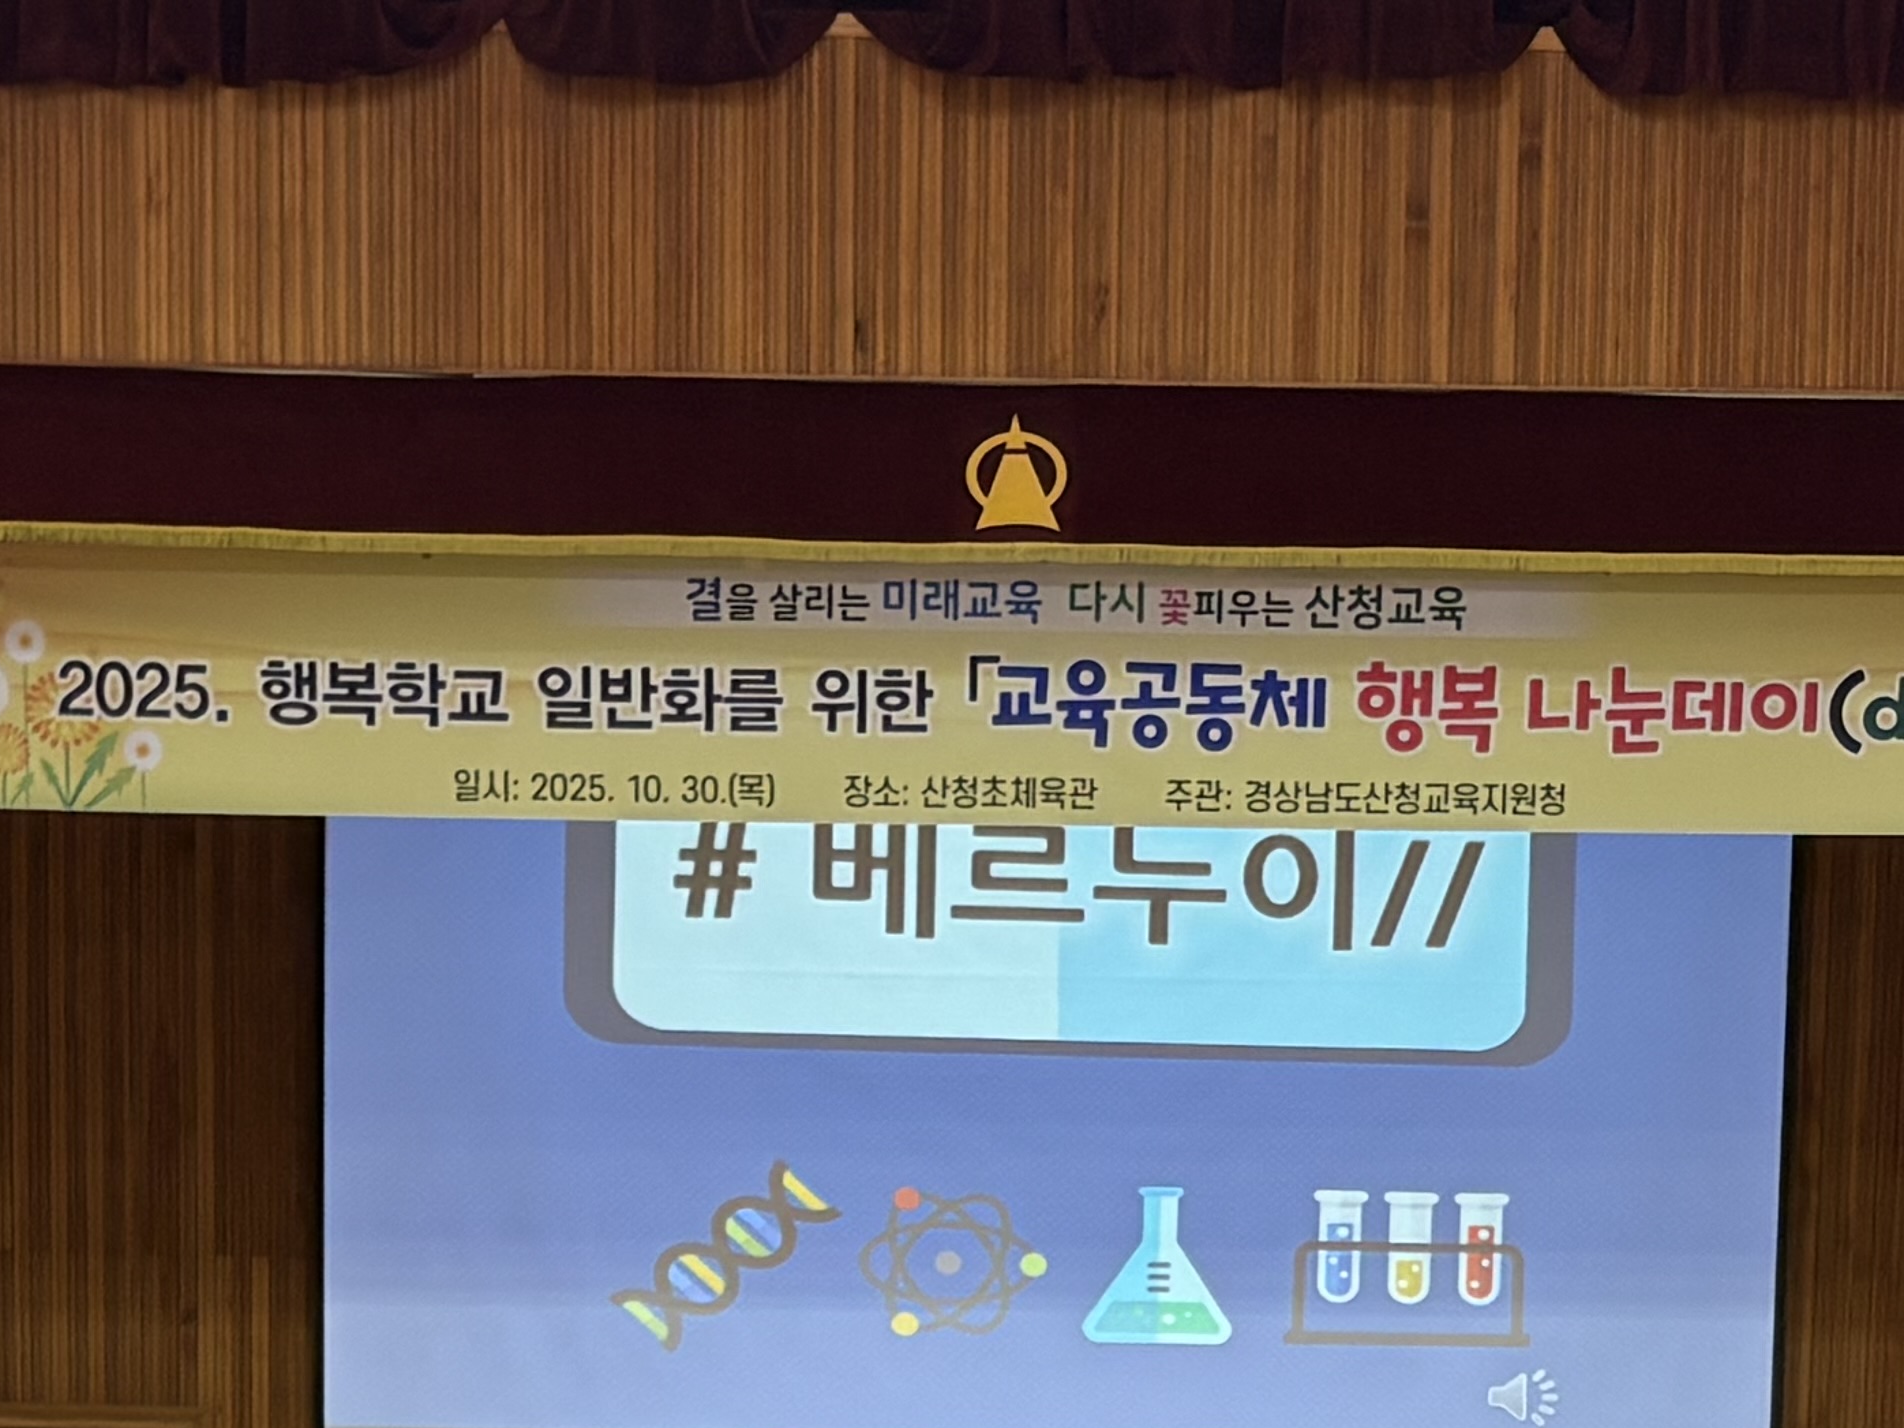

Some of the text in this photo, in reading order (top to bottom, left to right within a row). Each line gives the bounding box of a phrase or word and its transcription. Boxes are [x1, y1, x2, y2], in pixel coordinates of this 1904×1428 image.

[687, 577, 1467, 631] 결을 살리는 미래교육 다시 꽃피우는 산청교육
[56, 660, 230, 723] 2025.
[259, 660, 510, 727] 행복학교
[537, 665, 784, 733] 일반화를
[811, 668, 934, 734] 위한
[1355, 660, 1501, 753] 행복
[452, 768, 776, 808] 일시: 2025. 10. 30.(목)
[843, 774, 1098, 812] 장소: 산청초체육관
[1164, 779, 1567, 817] 주관: 경상남도산청교육지원청
